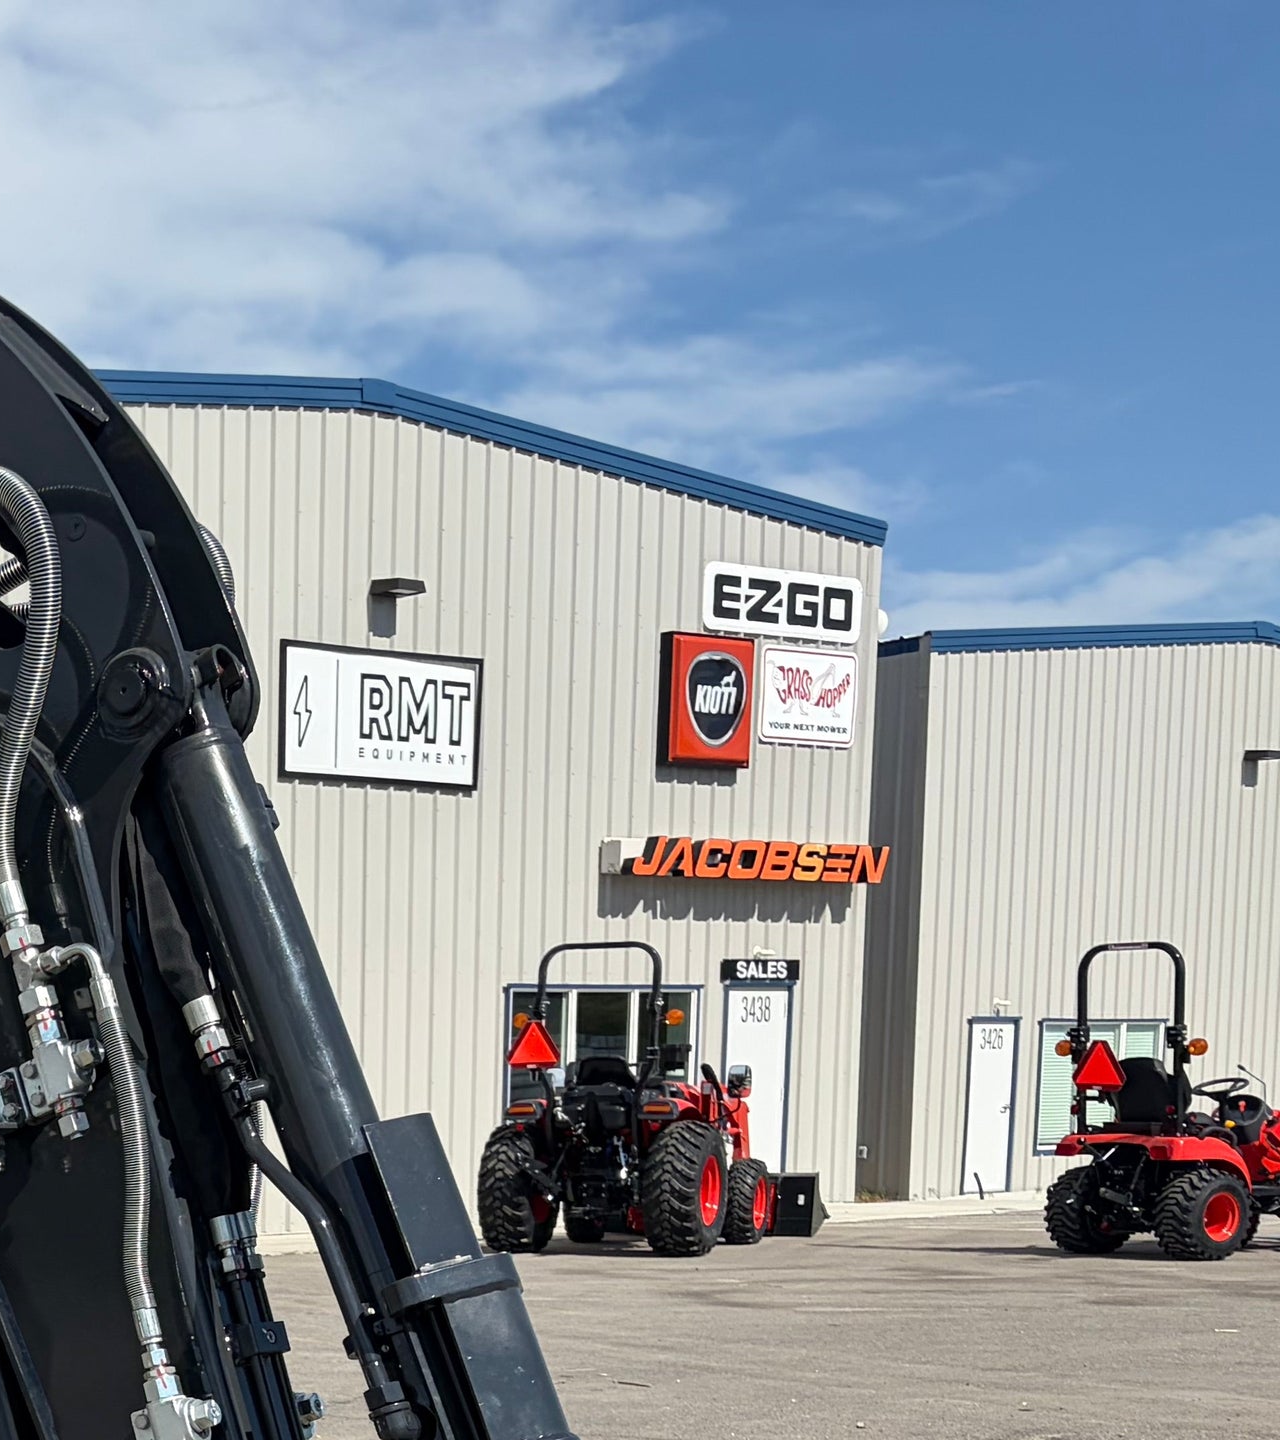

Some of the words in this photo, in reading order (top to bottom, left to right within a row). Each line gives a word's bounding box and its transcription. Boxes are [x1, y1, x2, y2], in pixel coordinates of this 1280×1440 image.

[359, 673, 471, 746] RMT
[694, 684, 737, 715] KIOTI
[768, 721, 791, 730] YOUR
[793, 723, 815, 732] NEXT
[816, 725, 848, 735] MOWER
[358, 747, 467, 765] EQUIPMENT
[631, 836, 890, 884] JACOBSEN
[736, 960, 788, 980] SALES
[740, 996, 771, 1023] 3438
[980, 1028, 1003, 1050] 3426
